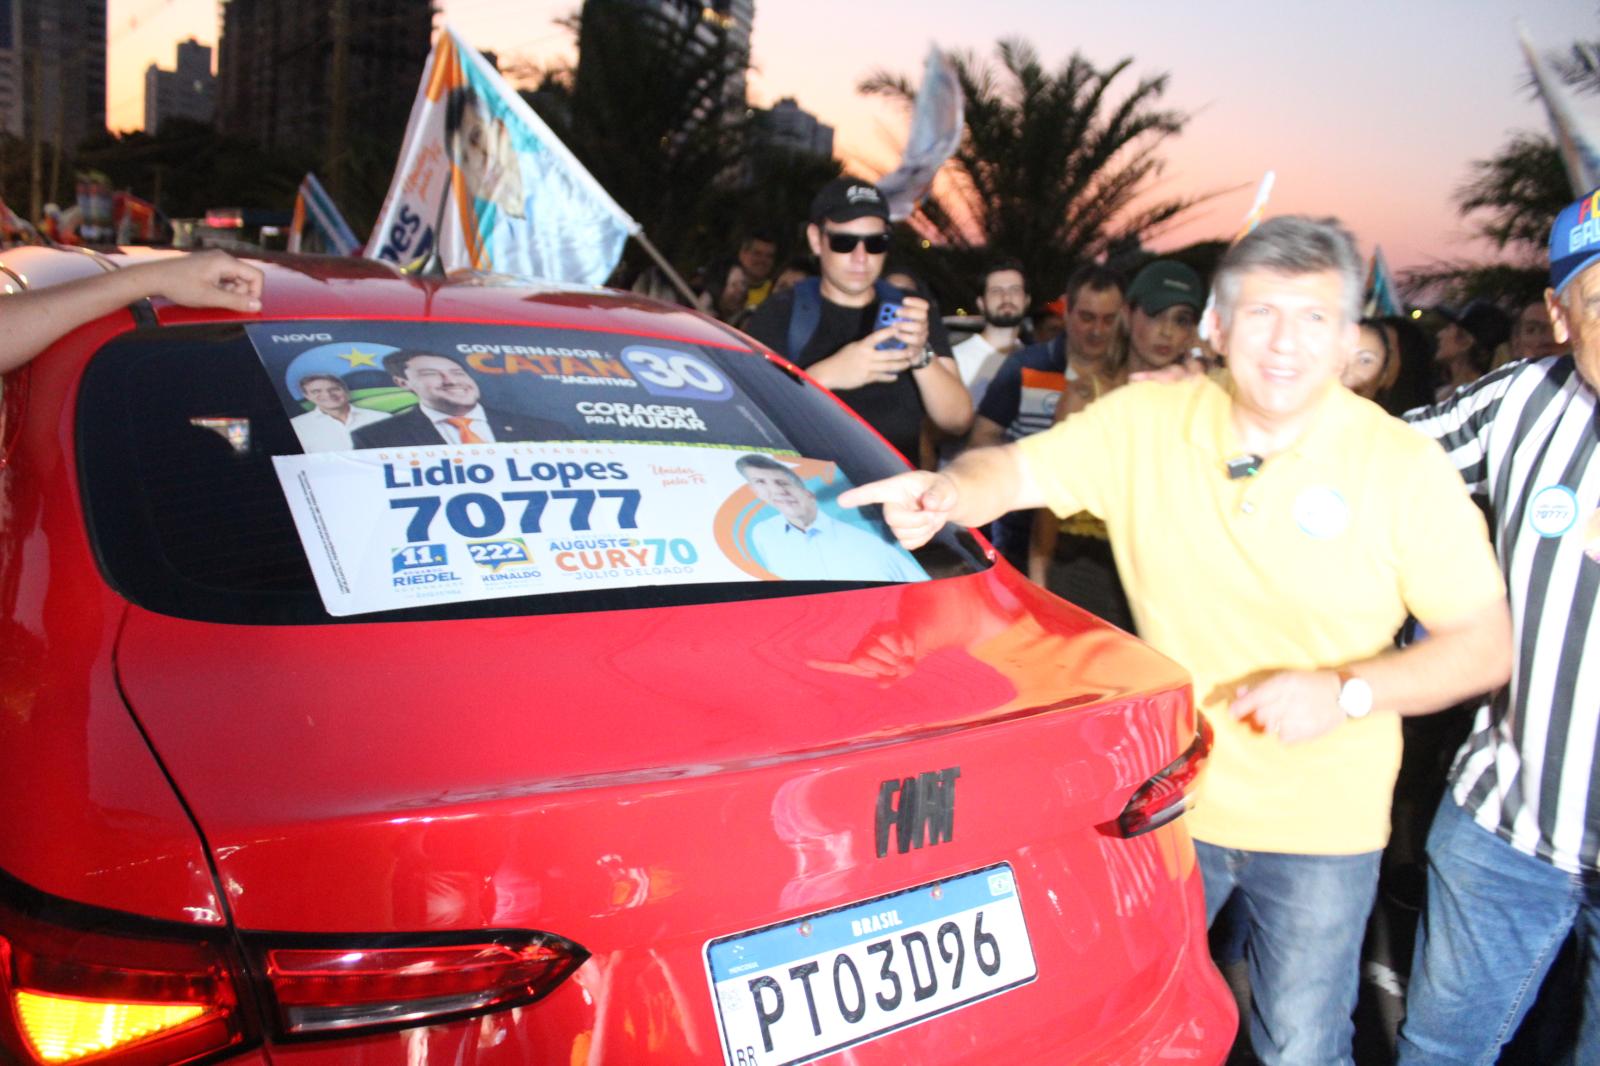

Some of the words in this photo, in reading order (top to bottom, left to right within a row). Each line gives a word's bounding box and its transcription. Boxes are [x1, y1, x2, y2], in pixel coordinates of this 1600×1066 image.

[271, 333, 332, 343] NOVO
[456, 344, 602, 359] GOVERNADOR
[466, 352, 631, 379] CATAN
[627, 350, 724, 392] 30
[576, 402, 697, 419] CORAGEM
[585, 415, 617, 425] PRA
[618, 414, 707, 431] MUDAR
[379, 448, 496, 460] DEPUTADO
[506, 458, 628, 488] Lopes
[389, 489, 641, 542] 70777
[470, 543, 523, 560] 222
[555, 548, 649, 572] CURY
[643, 538, 698, 565] 70
[393, 571, 461, 587] RIEDEL
[624, 566, 694, 577] DELGADO
[875, 766, 960, 858] FIAT
[851, 910, 902, 937] BRASIL
[736, 1046, 758, 1066] BR
